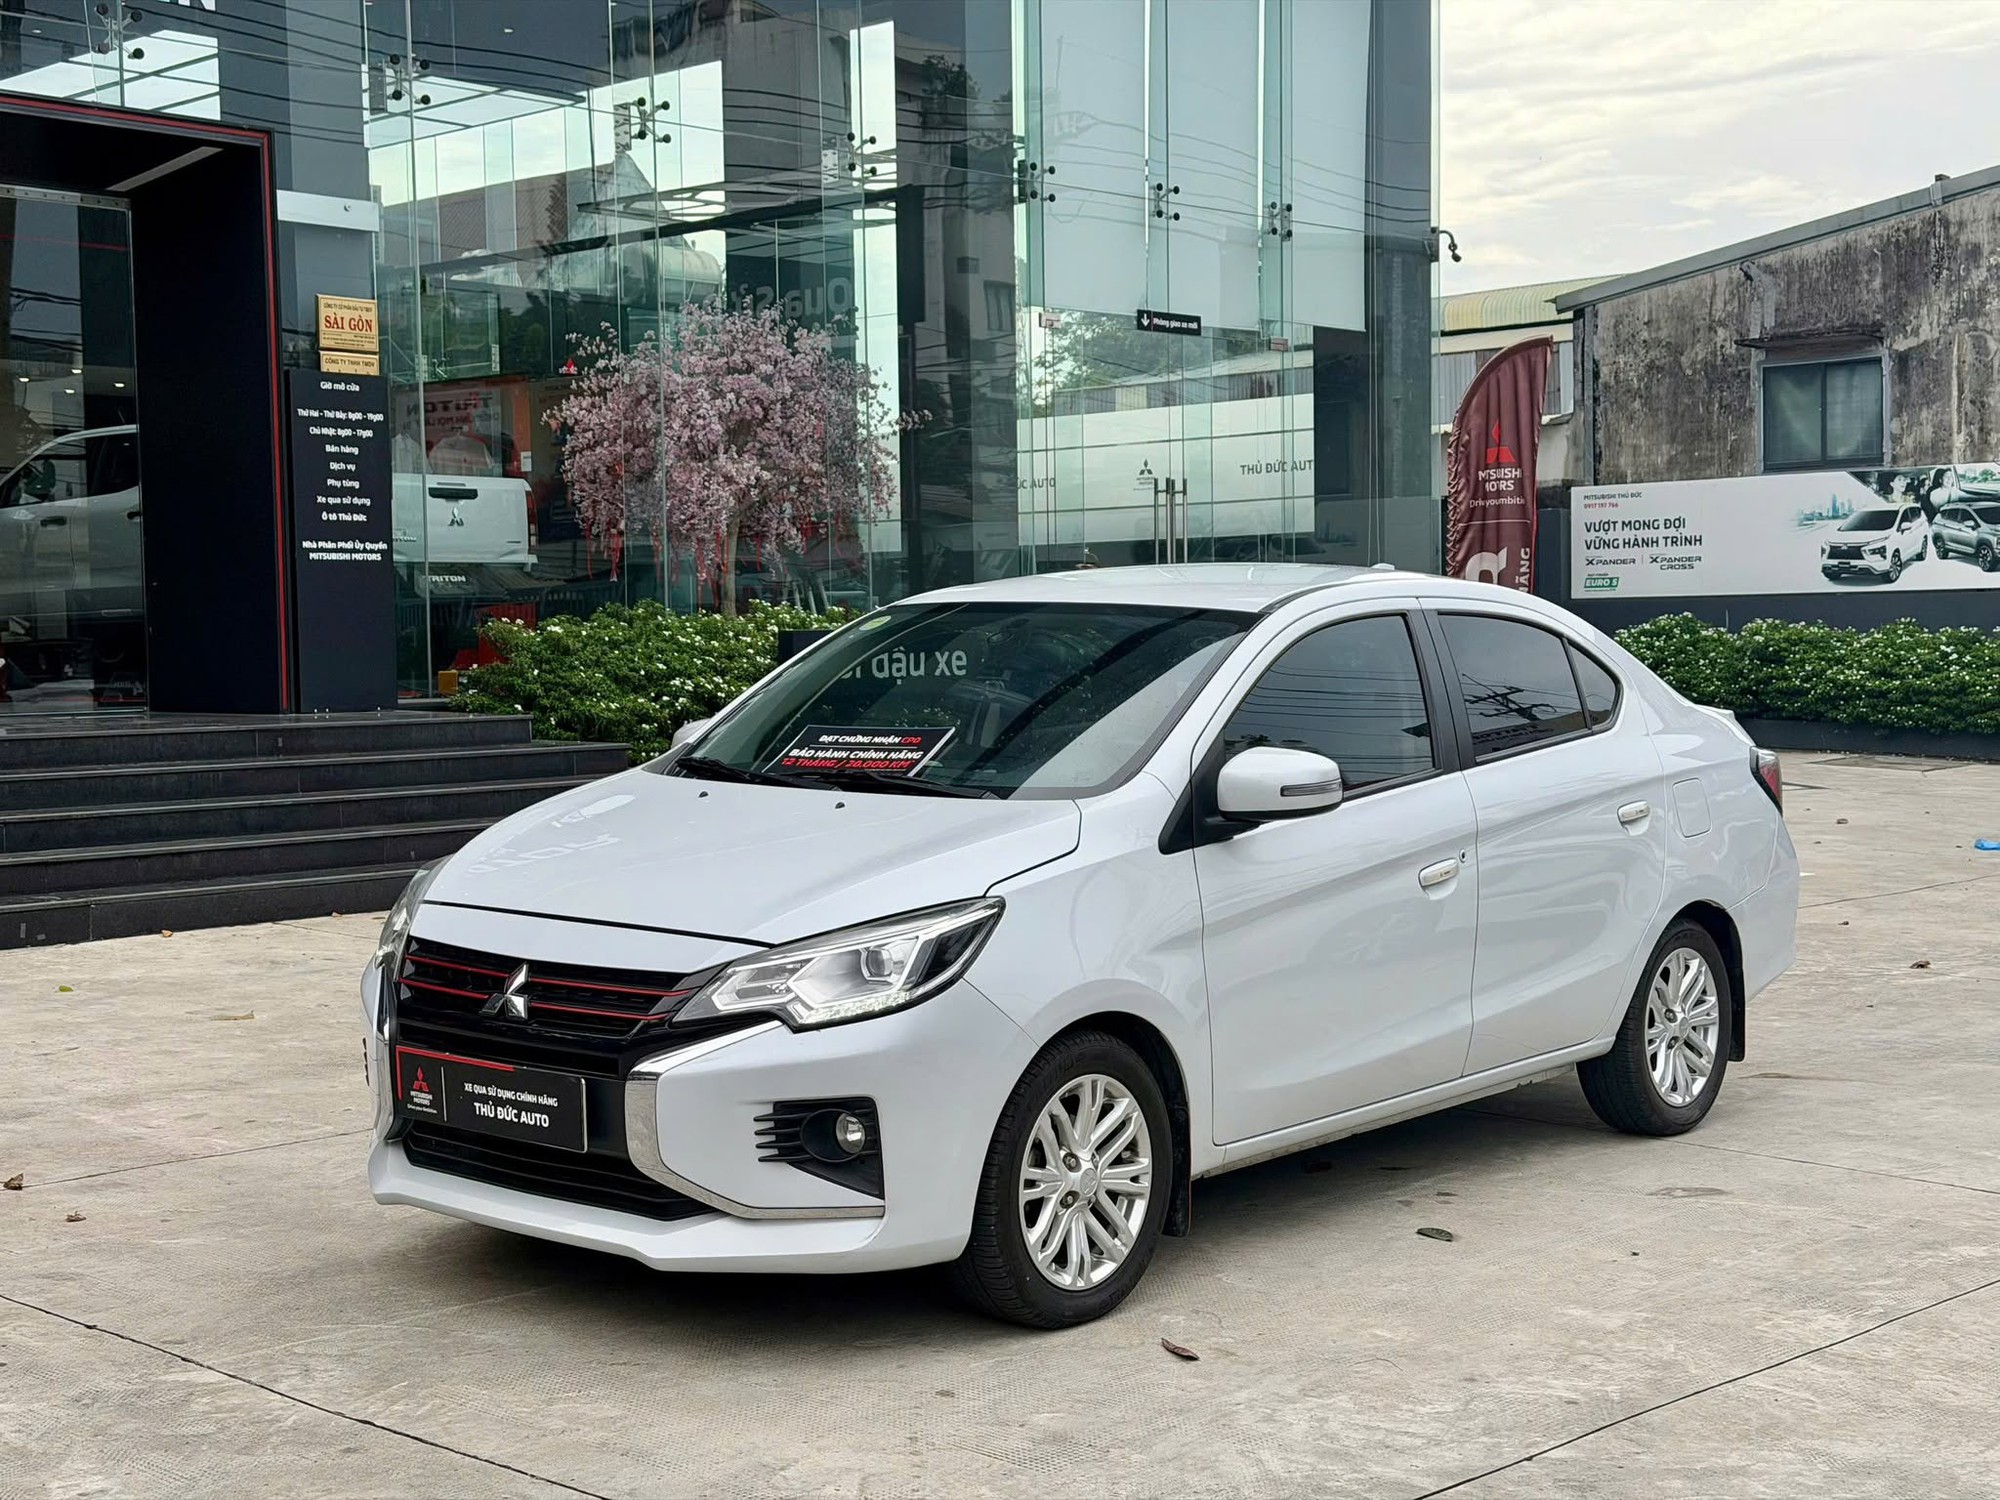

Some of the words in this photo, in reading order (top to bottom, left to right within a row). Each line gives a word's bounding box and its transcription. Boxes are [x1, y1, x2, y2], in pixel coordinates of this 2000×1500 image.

[324, 312, 345, 330] SÀI
[348, 314, 373, 333] GÒN
[325, 357, 339, 365] CÔNG
[320, 381, 332, 390] Giờ
[333, 382, 345, 391] mở
[346, 382, 360, 392] cửa
[297, 408, 309, 417] Thứ
[309, 409, 320, 417] Hai
[323, 409, 335, 418] Thứ
[348, 411, 363, 421] 8g00
[367, 413, 384, 422] 19g00
[309, 426, 321, 435] Chủ
[337, 428, 352, 438] 8g00
[356, 429, 373, 439] 17g00
[325, 444, 340, 453] Bán
[340, 445, 359, 456] hàng
[329, 461, 345, 471] Dịch
[346, 463, 356, 472] vụ
[1239, 459, 1263, 475] THỦ
[1265, 459, 1287, 474] ĐỨC
[1290, 459, 1313, 472] AUT
[327, 478, 341, 488] Phụ
[342, 479, 360, 489] tùng
[1030, 477, 1056, 489] AUTO
[316, 495, 326, 503] Xe
[327, 496, 341, 505] qua
[342, 495, 352, 504] sử
[352, 496, 371, 507] dụng
[321, 511, 328, 521] Ô
[328, 512, 338, 521] tô
[338, 512, 352, 521] Thủ
[352, 513, 367, 522] Đức
[1584, 519, 1619, 535] VƯỢT
[1621, 519, 1661, 532] MONG
[1663, 516, 1686, 532] ĐỢI
[302, 540, 317, 549] Nhà
[317, 541, 337, 549] Phân
[337, 540, 354, 549] Phối
[354, 539, 364, 551] Ủy
[1584, 535, 1620, 551] VỮNG
[1622, 534, 1659, 549] HÀNH
[1662, 532, 1703, 548] TRÌNH
[309, 552, 350, 560] MITSUBISHI
[351, 553, 382, 561] MOTORS
[1585, 558, 1636, 566] XPANDER
[1649, 556, 1702, 564] XPANDER
[1585, 578, 1611, 587] EURO
[935, 650, 967, 676] xe
[819, 734, 840, 744] ĐẠT
[871, 735, 902, 745] NHẬN
[788, 747, 816, 757] BẢO
[813, 748, 850, 758] HÀNH
[849, 749, 889, 759] CHÍNH
[887, 750, 924, 759] HÃNG
[781, 758, 797, 766] 12
[796, 758, 837, 767] THÁNG
[845, 760, 890, 768] 20.000
[464, 1082, 473, 1092] XE
[473, 1084, 487, 1095] QUA
[487, 1084, 497, 1096] SỬ
[497, 1088, 516, 1100] DỤNG
[516, 1091, 537, 1104] CHÍNH
[538, 1094, 558, 1107] HÃNG
[473, 1100, 495, 1118] THỦ
[496, 1105, 519, 1122] ĐỨC
[520, 1110, 549, 1128] AUTO
